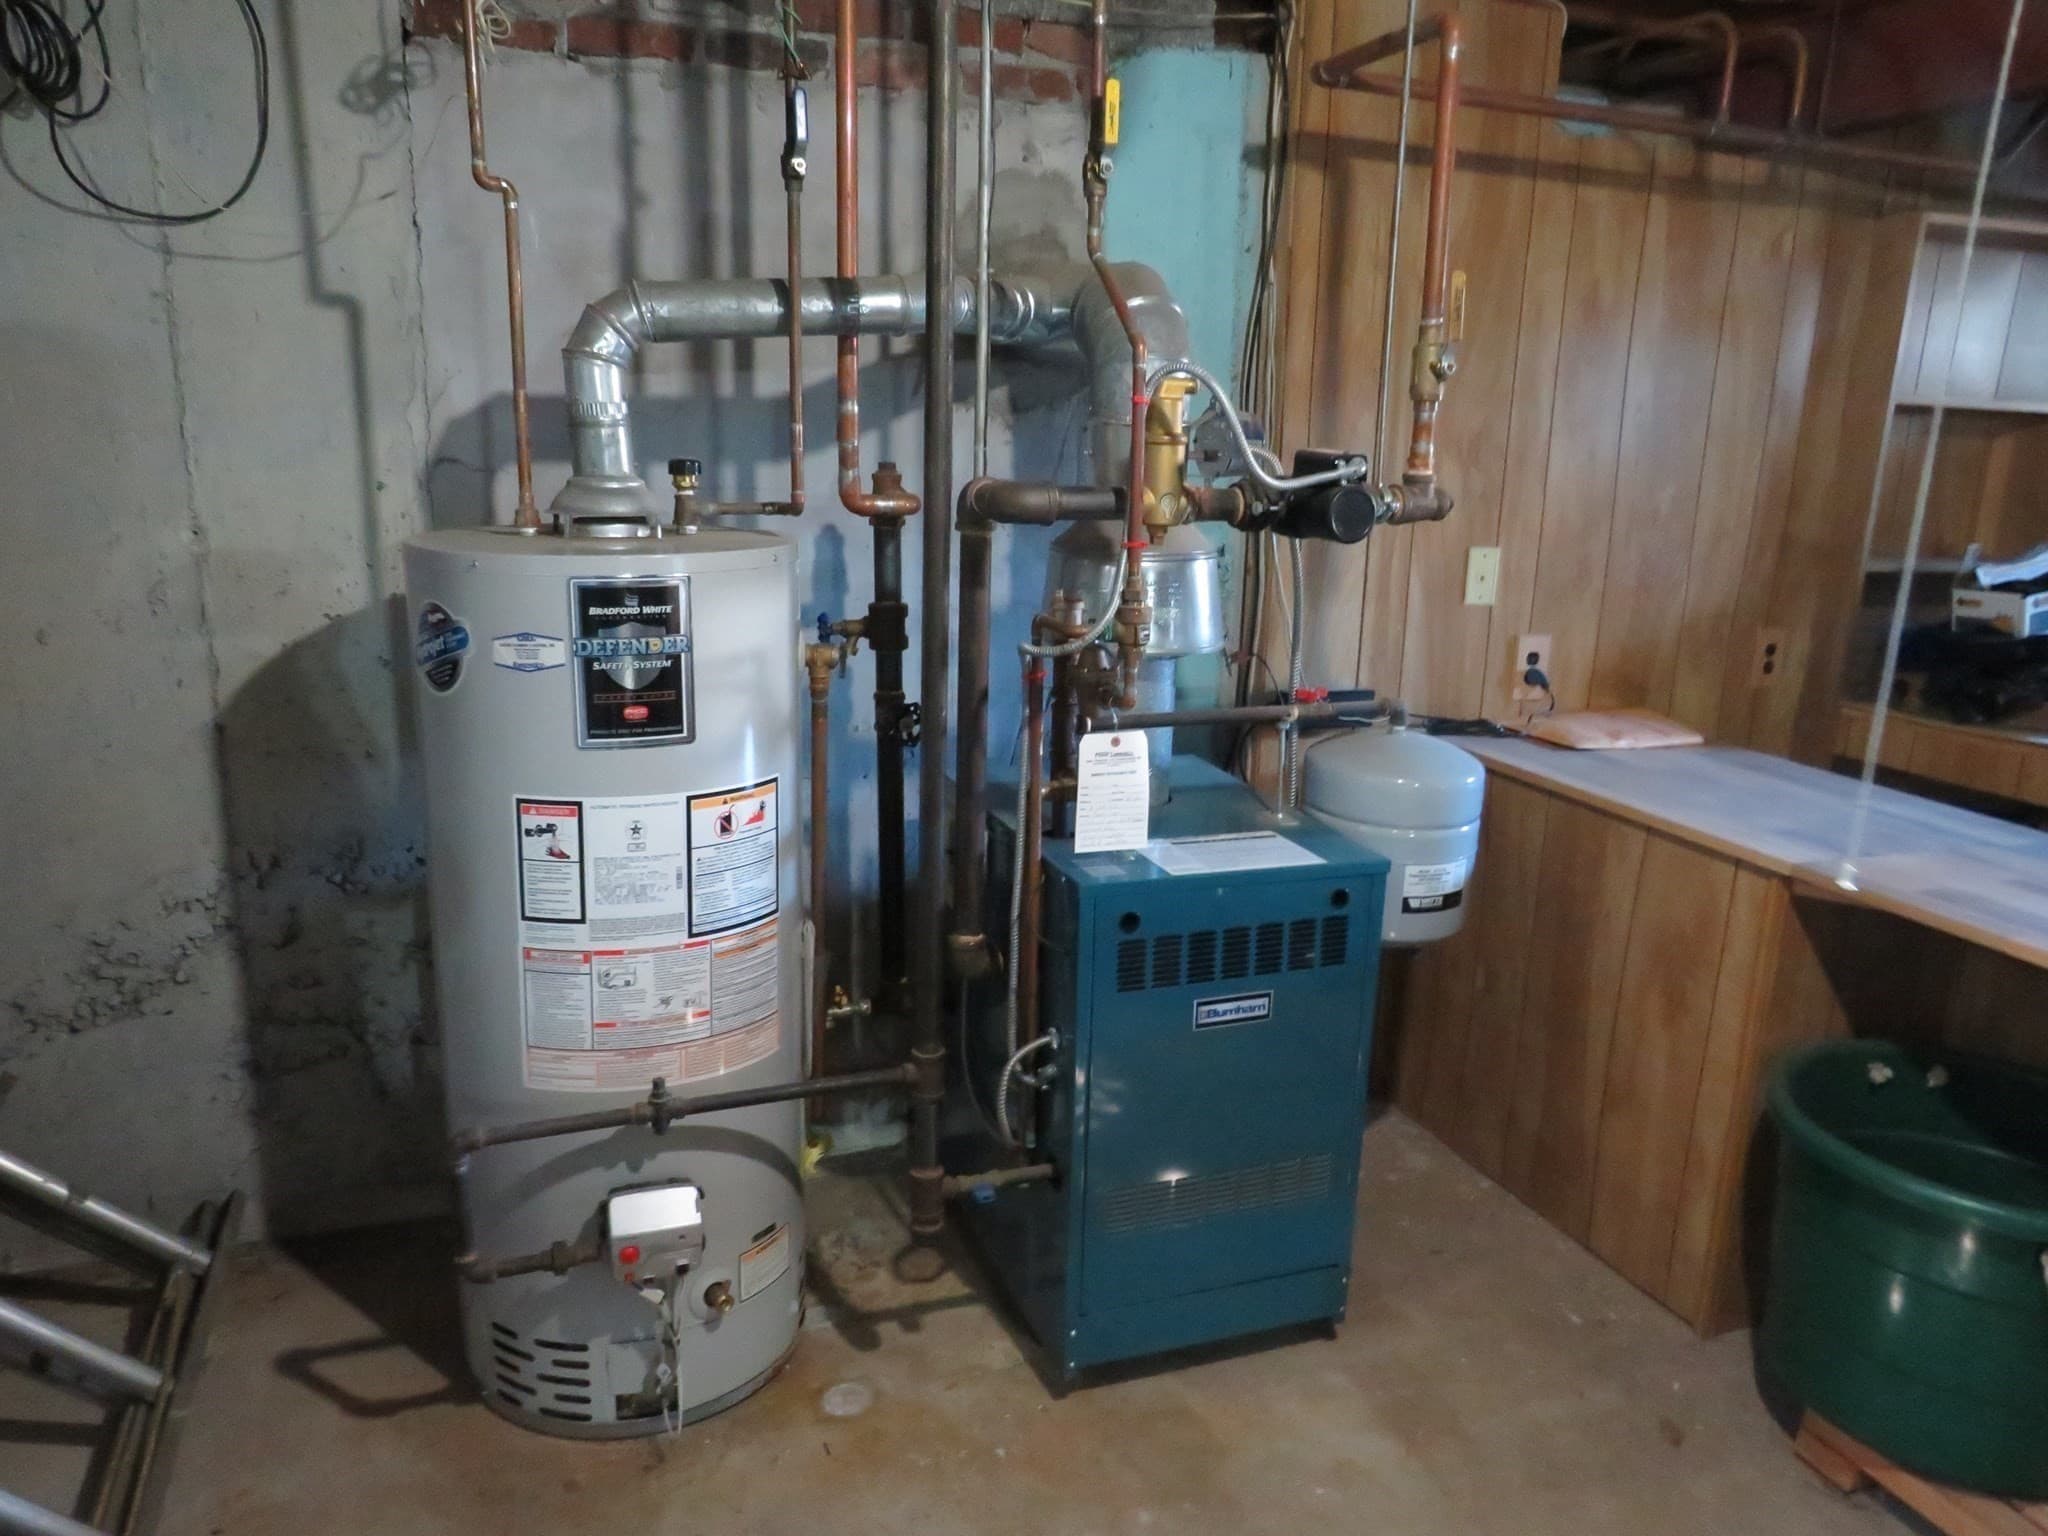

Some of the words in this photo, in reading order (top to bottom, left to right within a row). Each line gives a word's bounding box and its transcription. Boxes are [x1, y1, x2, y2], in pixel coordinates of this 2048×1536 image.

[589, 607, 641, 615] BRADFORD
[642, 605, 673, 614] WHITE
[575, 636, 689, 655] DEFENDER
[592, 662, 629, 671] SAFET
[632, 660, 672, 669] SYSTEM
[1207, 1004, 1267, 1019] Burnham
